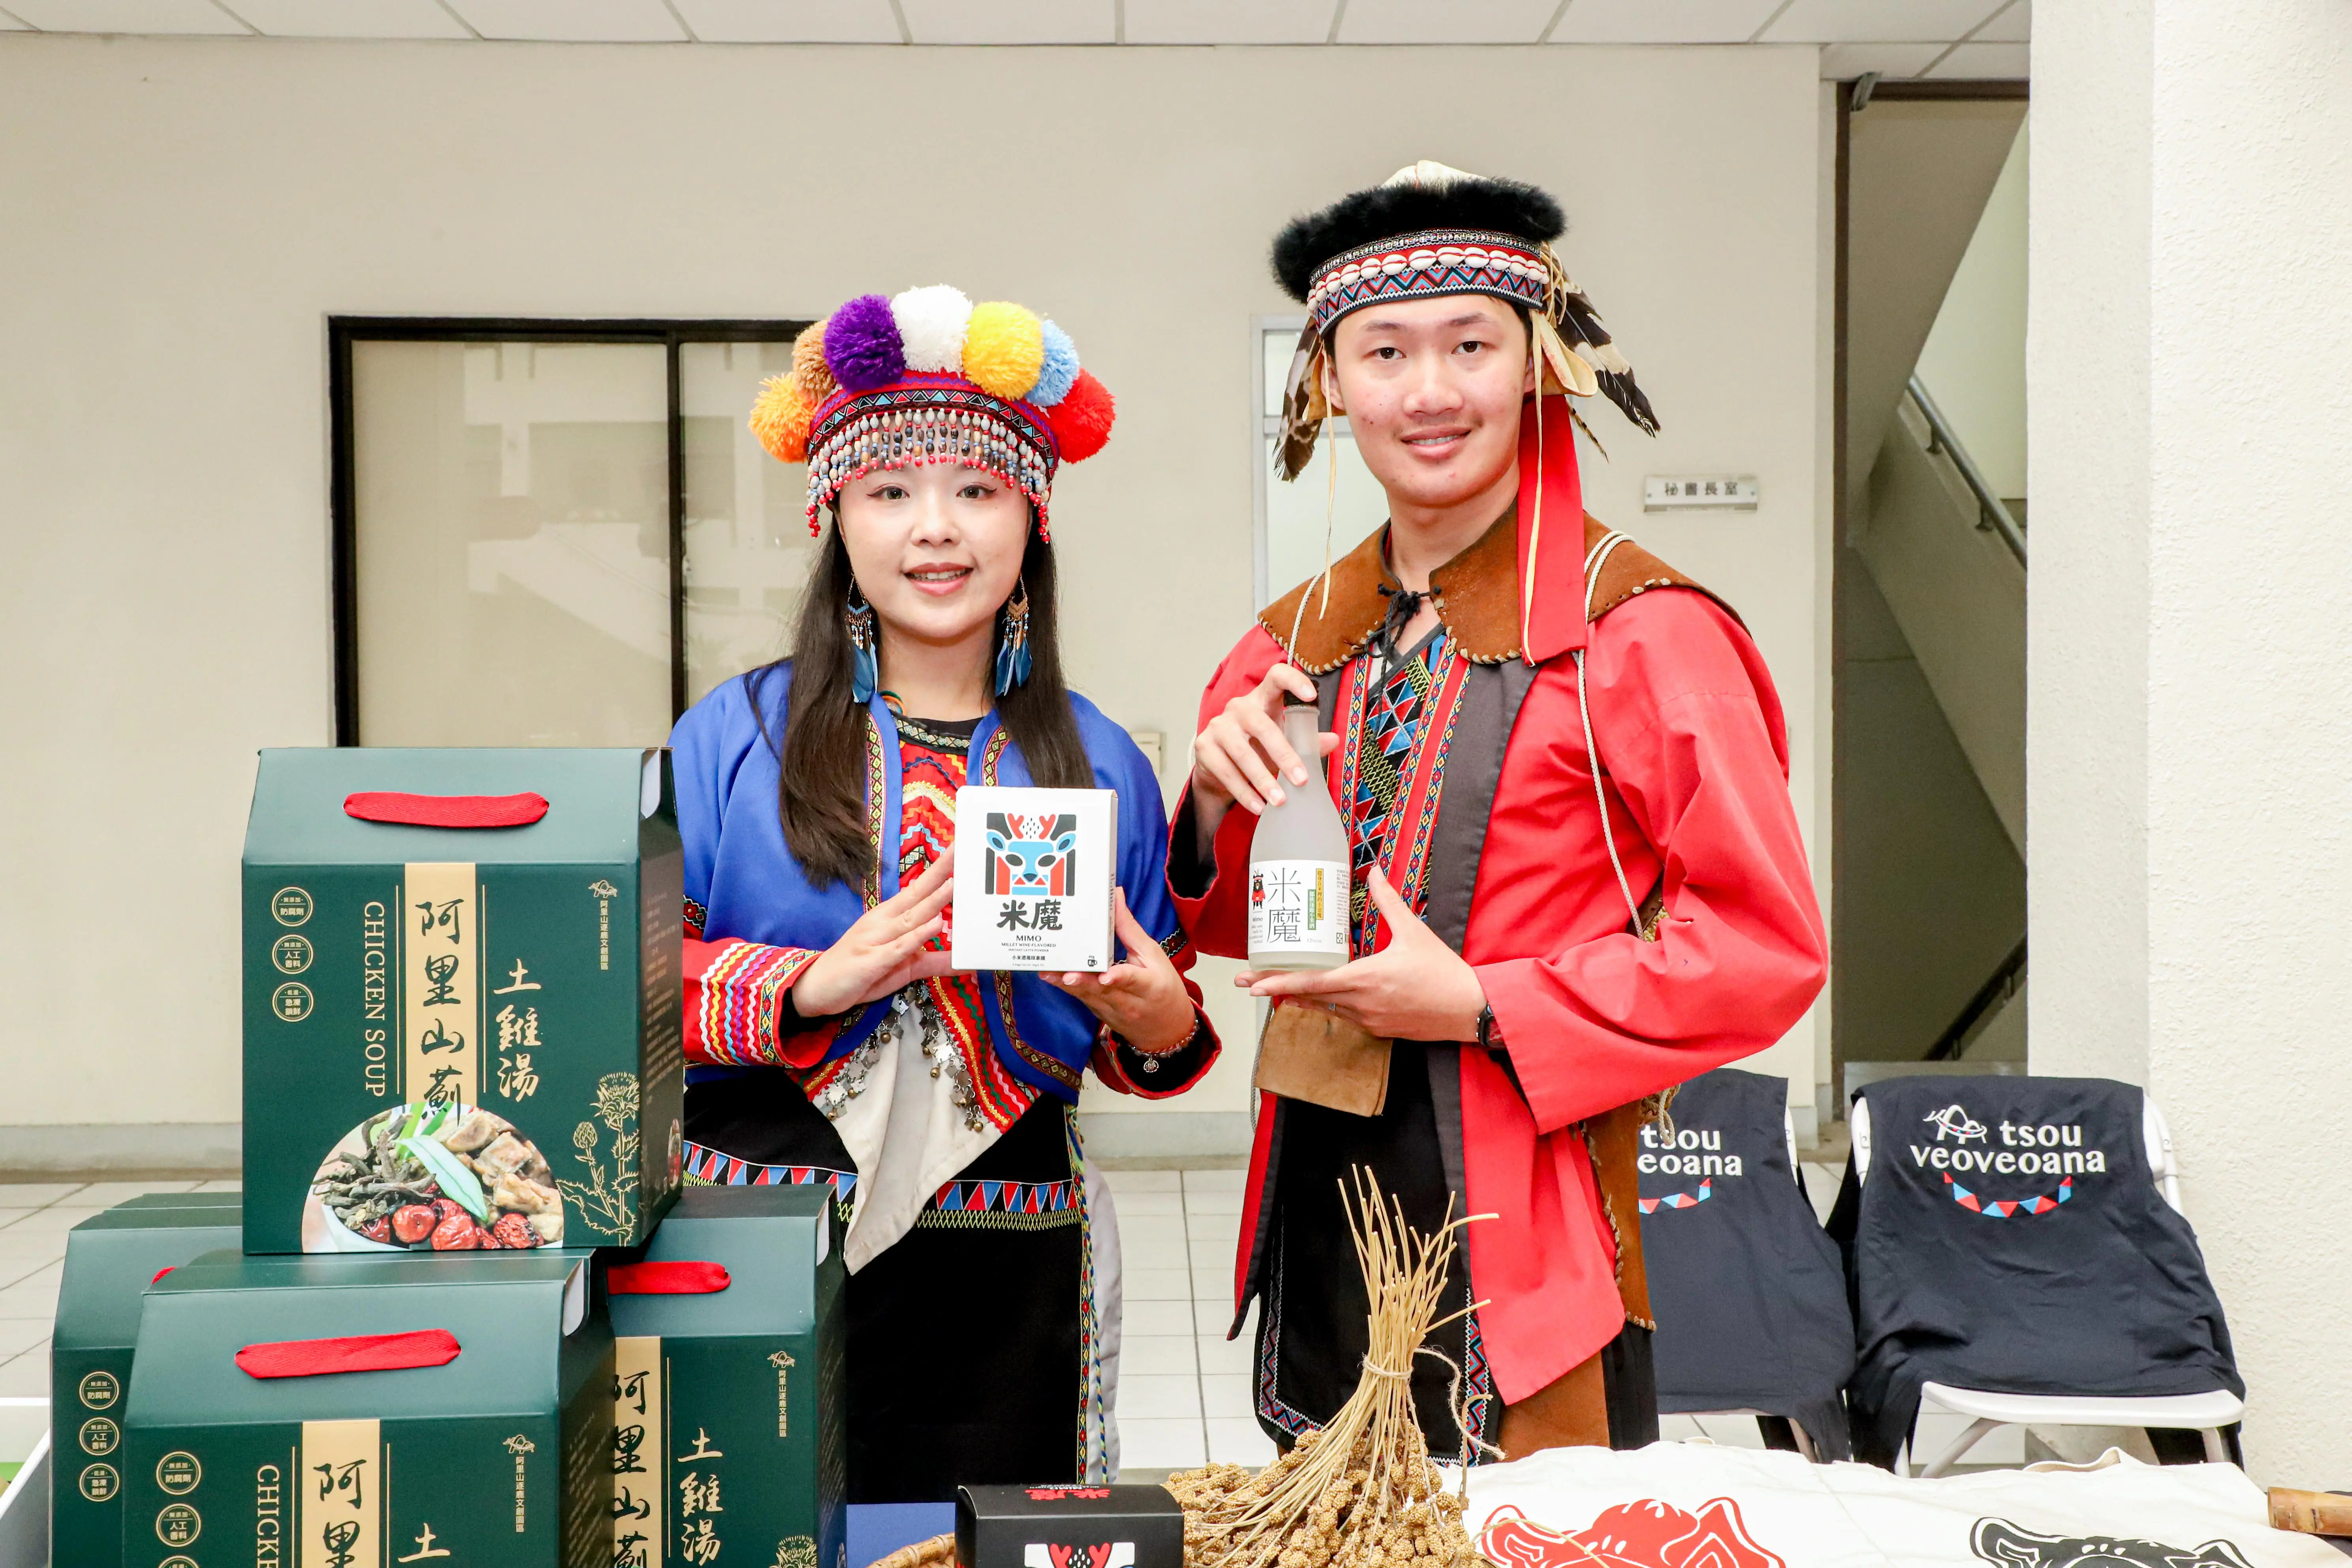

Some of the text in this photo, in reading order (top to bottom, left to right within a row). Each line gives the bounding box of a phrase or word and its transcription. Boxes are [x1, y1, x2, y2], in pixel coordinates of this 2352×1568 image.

[997, 899, 1063, 931] 米魔
[1267, 867, 1301, 943] 米魔
[365, 901, 385, 1098] CHICKEN SOUP
[416, 899, 465, 1127] 阿里山薊
[494, 959, 543, 1103] 土雞湯
[1999, 1120, 2081, 1147] tsou
[1909, 1145, 2106, 1174] veoveoana
[87, 1391, 110, 1400] 防腐劑
[165, 1474, 191, 1483] 防腐劑
[516, 1457, 524, 1532] 阿里山逐鹿文創園區
[677, 1427, 723, 1566] 土雞湯
[170, 1522, 187, 1530] 人工
[170, 1531, 187, 1540] 香料
[398, 1522, 451, 1563] 土
